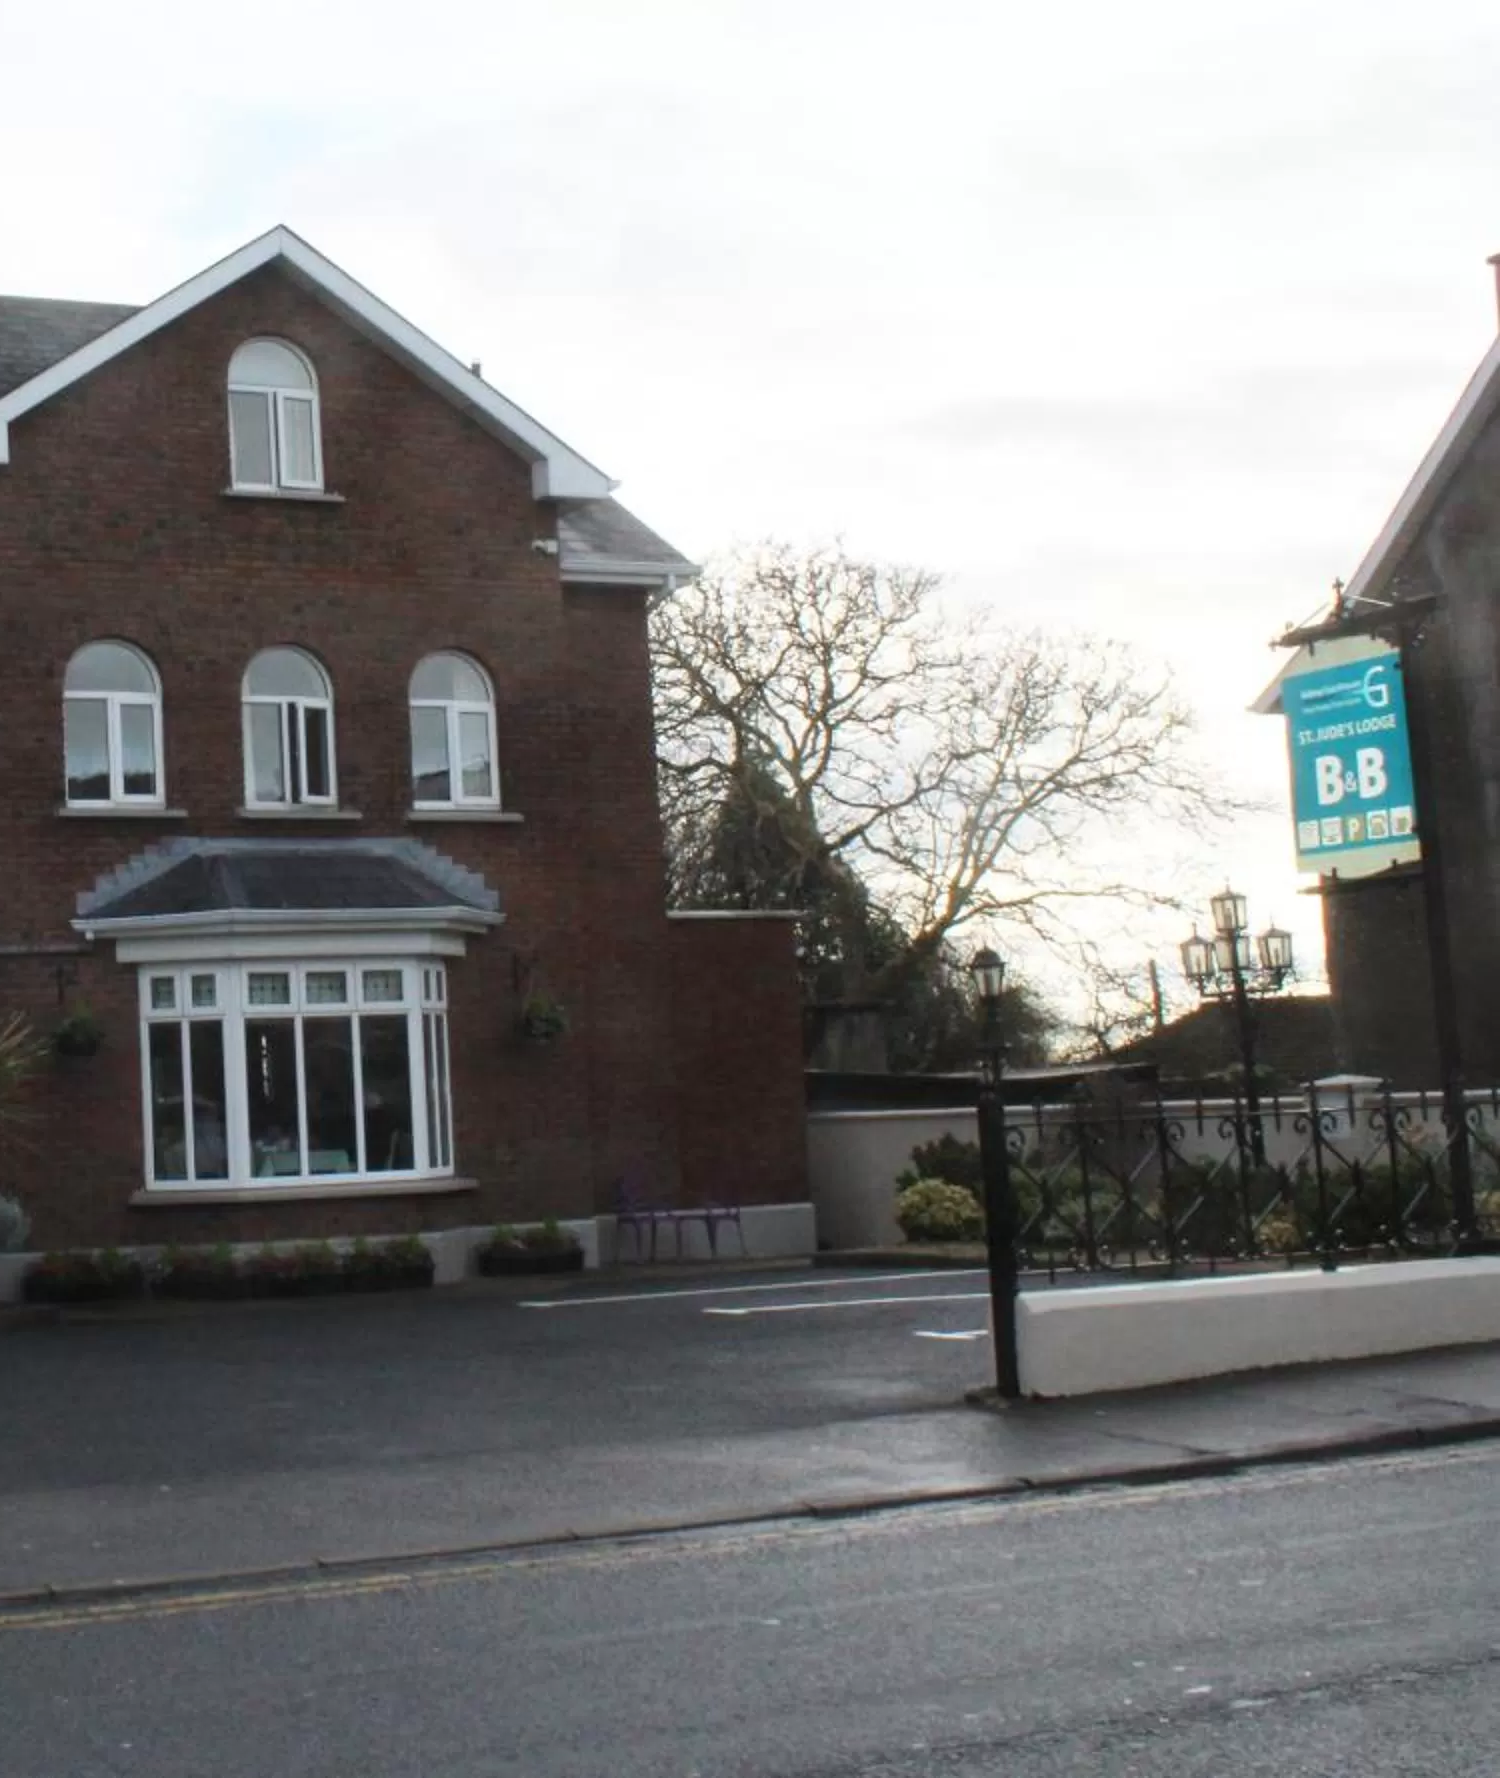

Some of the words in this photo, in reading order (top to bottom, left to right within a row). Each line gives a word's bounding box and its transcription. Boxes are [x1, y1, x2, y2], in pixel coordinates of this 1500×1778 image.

[1317, 723, 1354, 743] JUDE'S
[1356, 714, 1397, 733] LODGE
[1315, 747, 1387, 805] B&B
